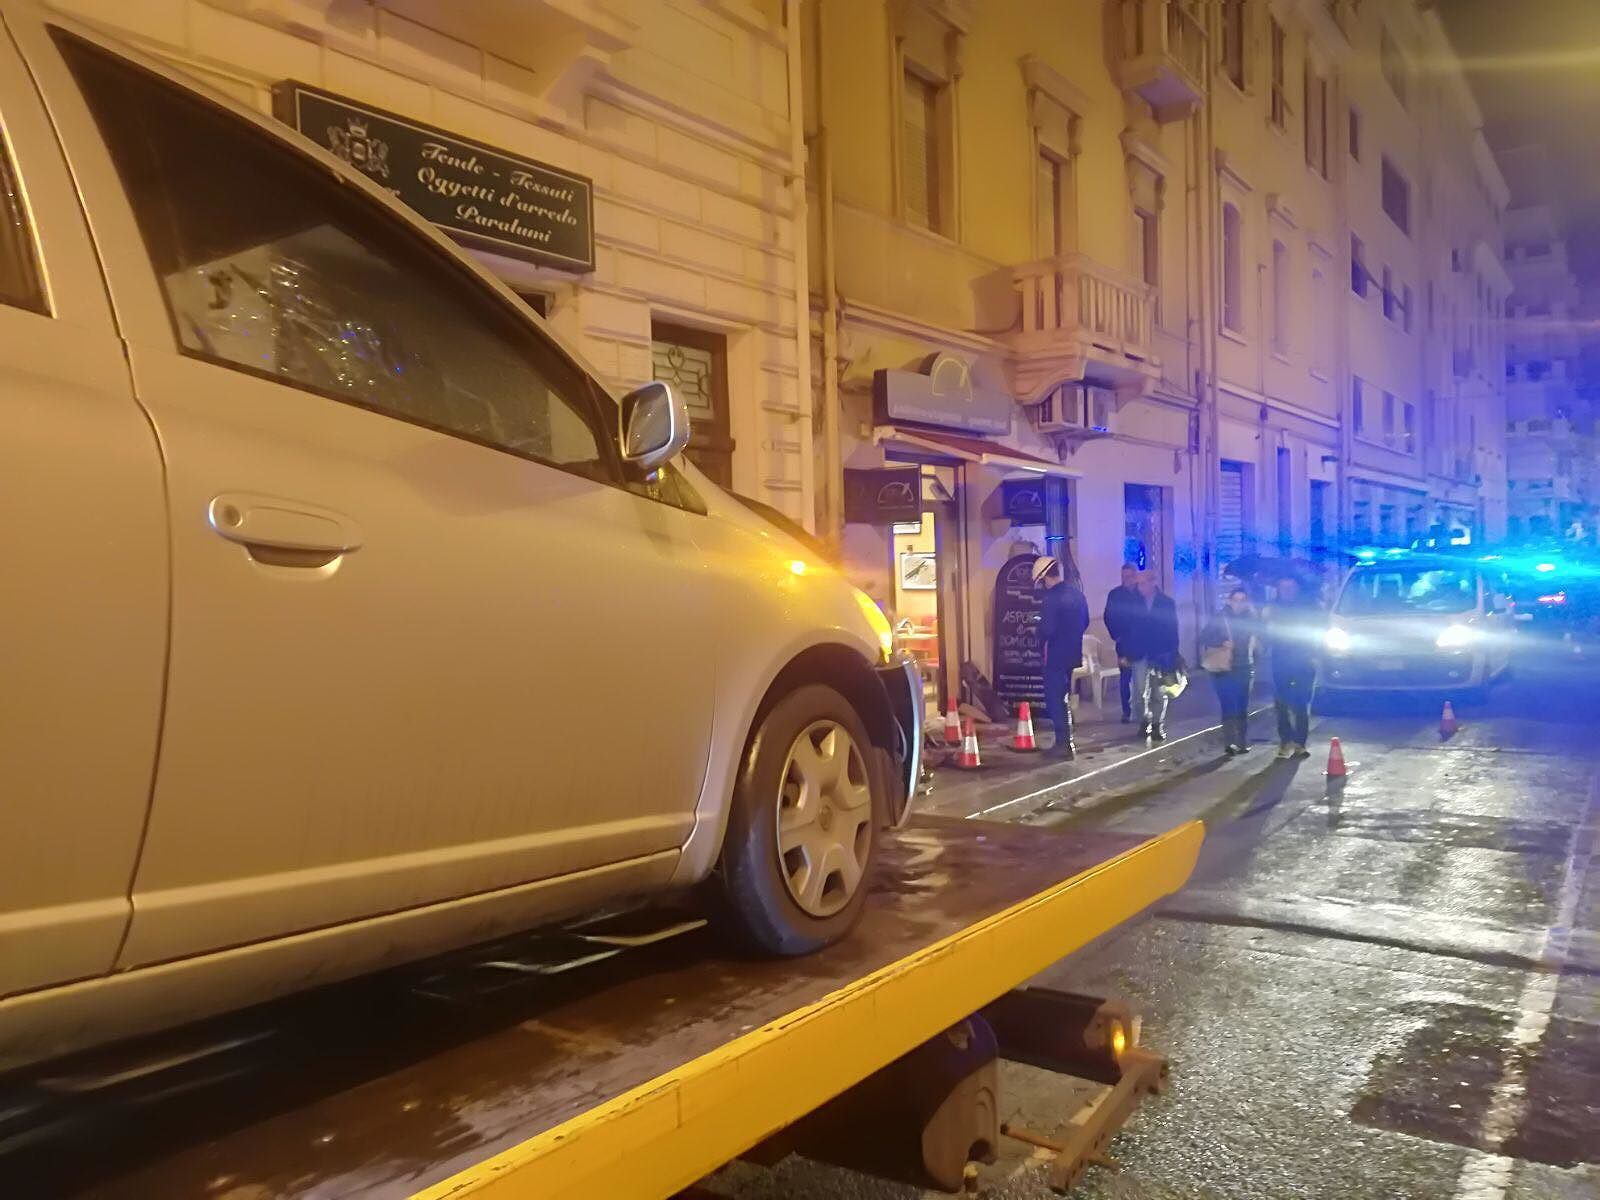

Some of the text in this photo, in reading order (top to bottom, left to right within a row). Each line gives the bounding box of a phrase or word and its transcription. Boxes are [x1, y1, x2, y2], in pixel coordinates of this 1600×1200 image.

[417, 167, 578, 226] Oggetti d'arredo
[421, 142, 484, 175] Tende
[510, 170, 574, 202] Tessuti
[456, 203, 551, 243] Paralumi
